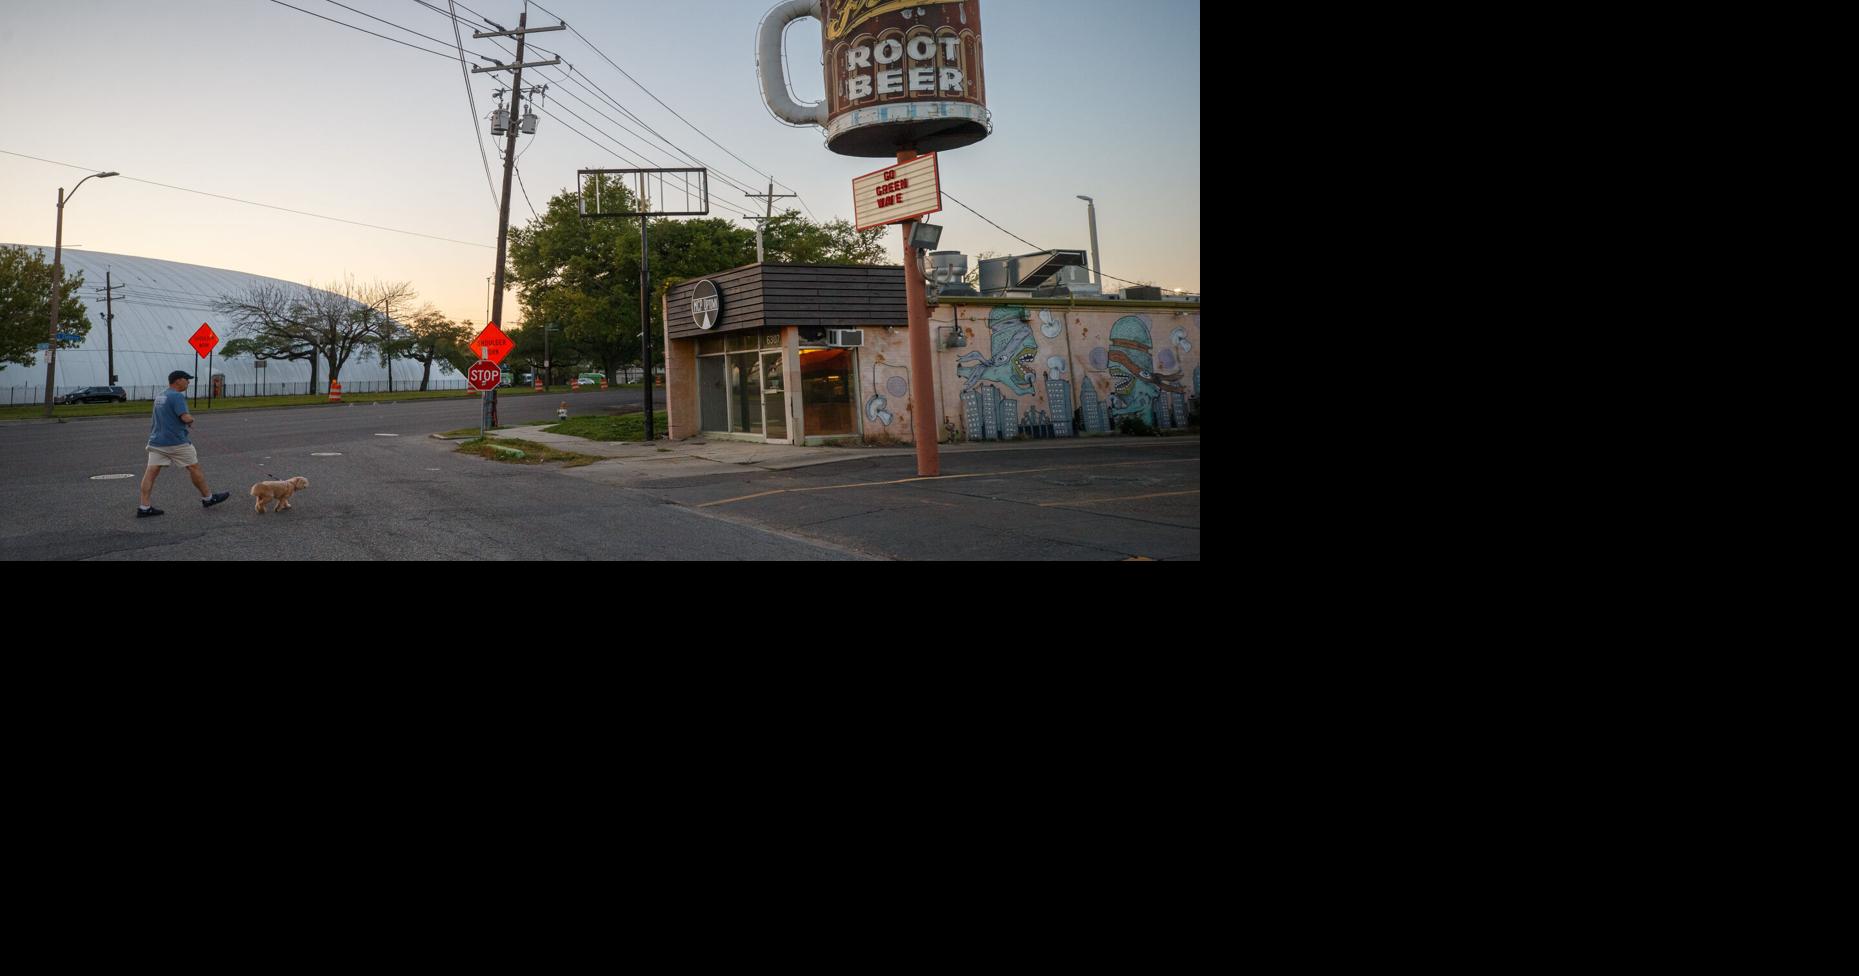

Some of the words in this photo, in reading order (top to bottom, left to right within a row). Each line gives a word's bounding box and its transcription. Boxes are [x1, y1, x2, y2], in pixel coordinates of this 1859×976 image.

[846, 36, 960, 71] ROOT
[846, 67, 963, 100] BEER
[883, 170, 896, 181] GO
[876, 178, 909, 196] GREEN
[470, 369, 499, 382] STOP
